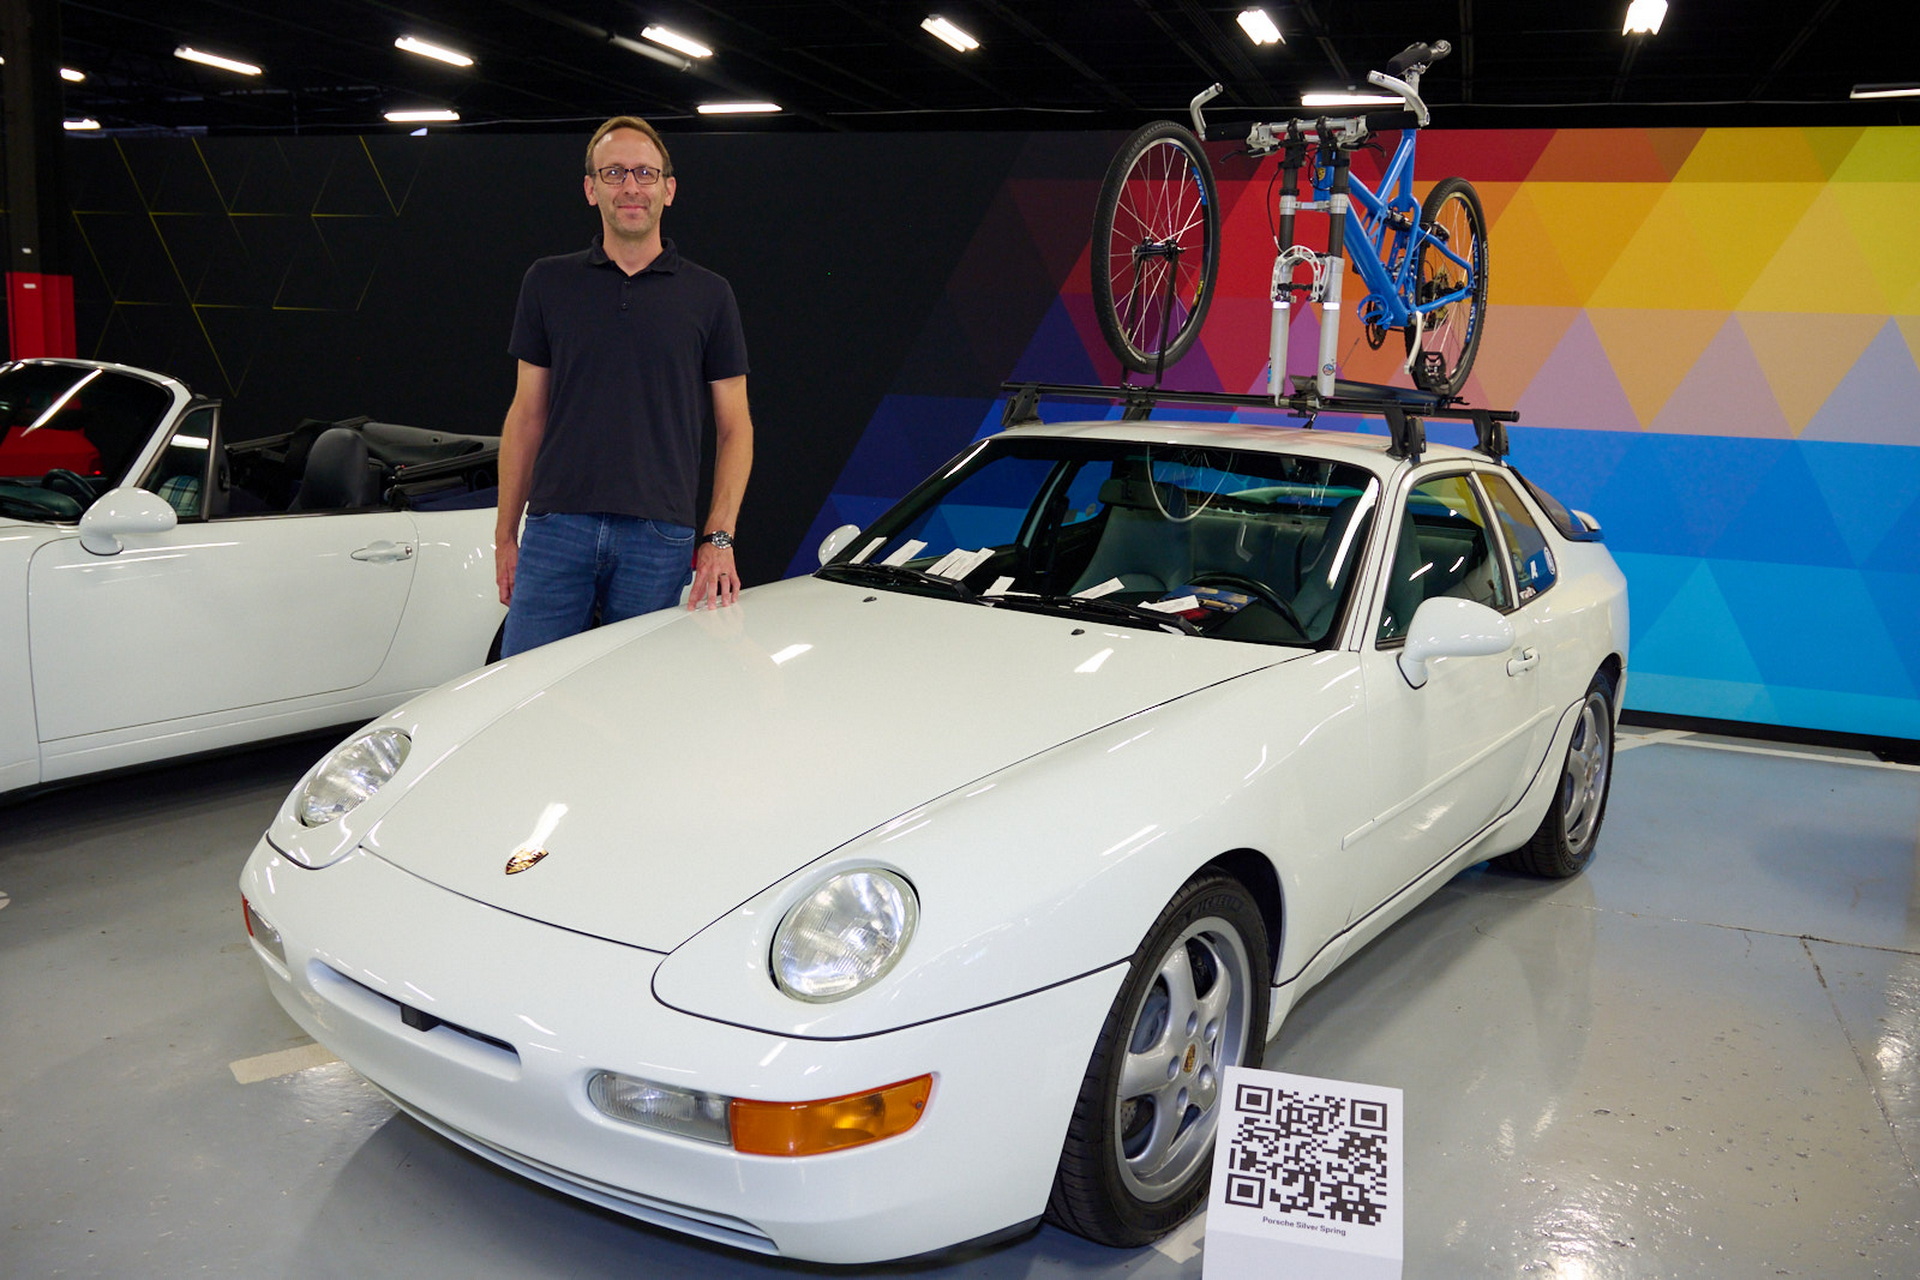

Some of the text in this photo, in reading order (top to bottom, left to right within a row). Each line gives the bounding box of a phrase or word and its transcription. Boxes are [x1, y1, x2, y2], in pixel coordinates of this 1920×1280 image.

[1262, 1216, 1346, 1236] Porsche Silver Spring
